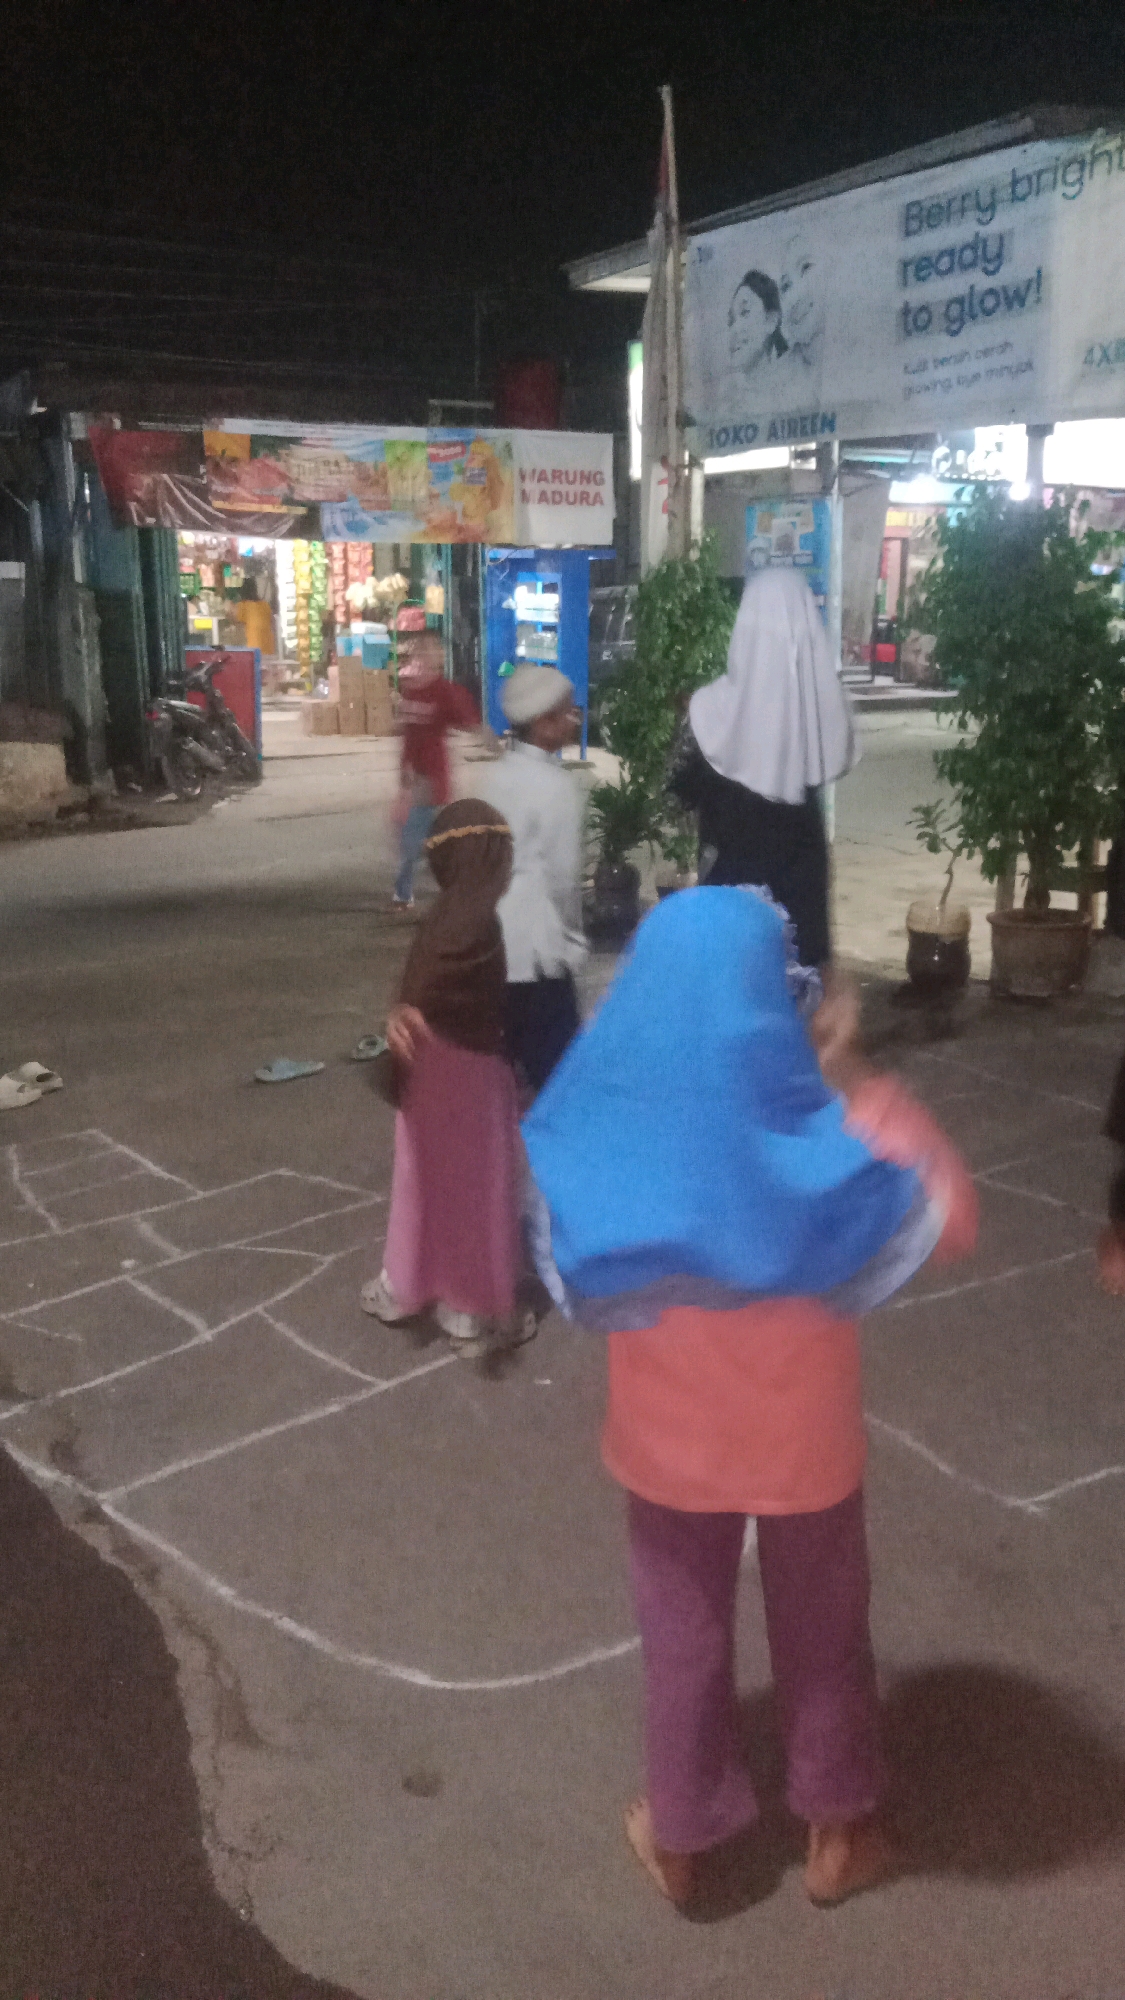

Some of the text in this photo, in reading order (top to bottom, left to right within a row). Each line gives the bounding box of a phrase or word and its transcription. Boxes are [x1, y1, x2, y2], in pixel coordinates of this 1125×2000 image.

[904, 186, 998, 237] Berry
[901, 231, 1005, 287] ready
[902, 266, 1043, 336] to glow!
[707, 422, 760, 449] TOKO
[518, 467, 606, 487] WARUNG
[520, 488, 605, 507] MADURA
